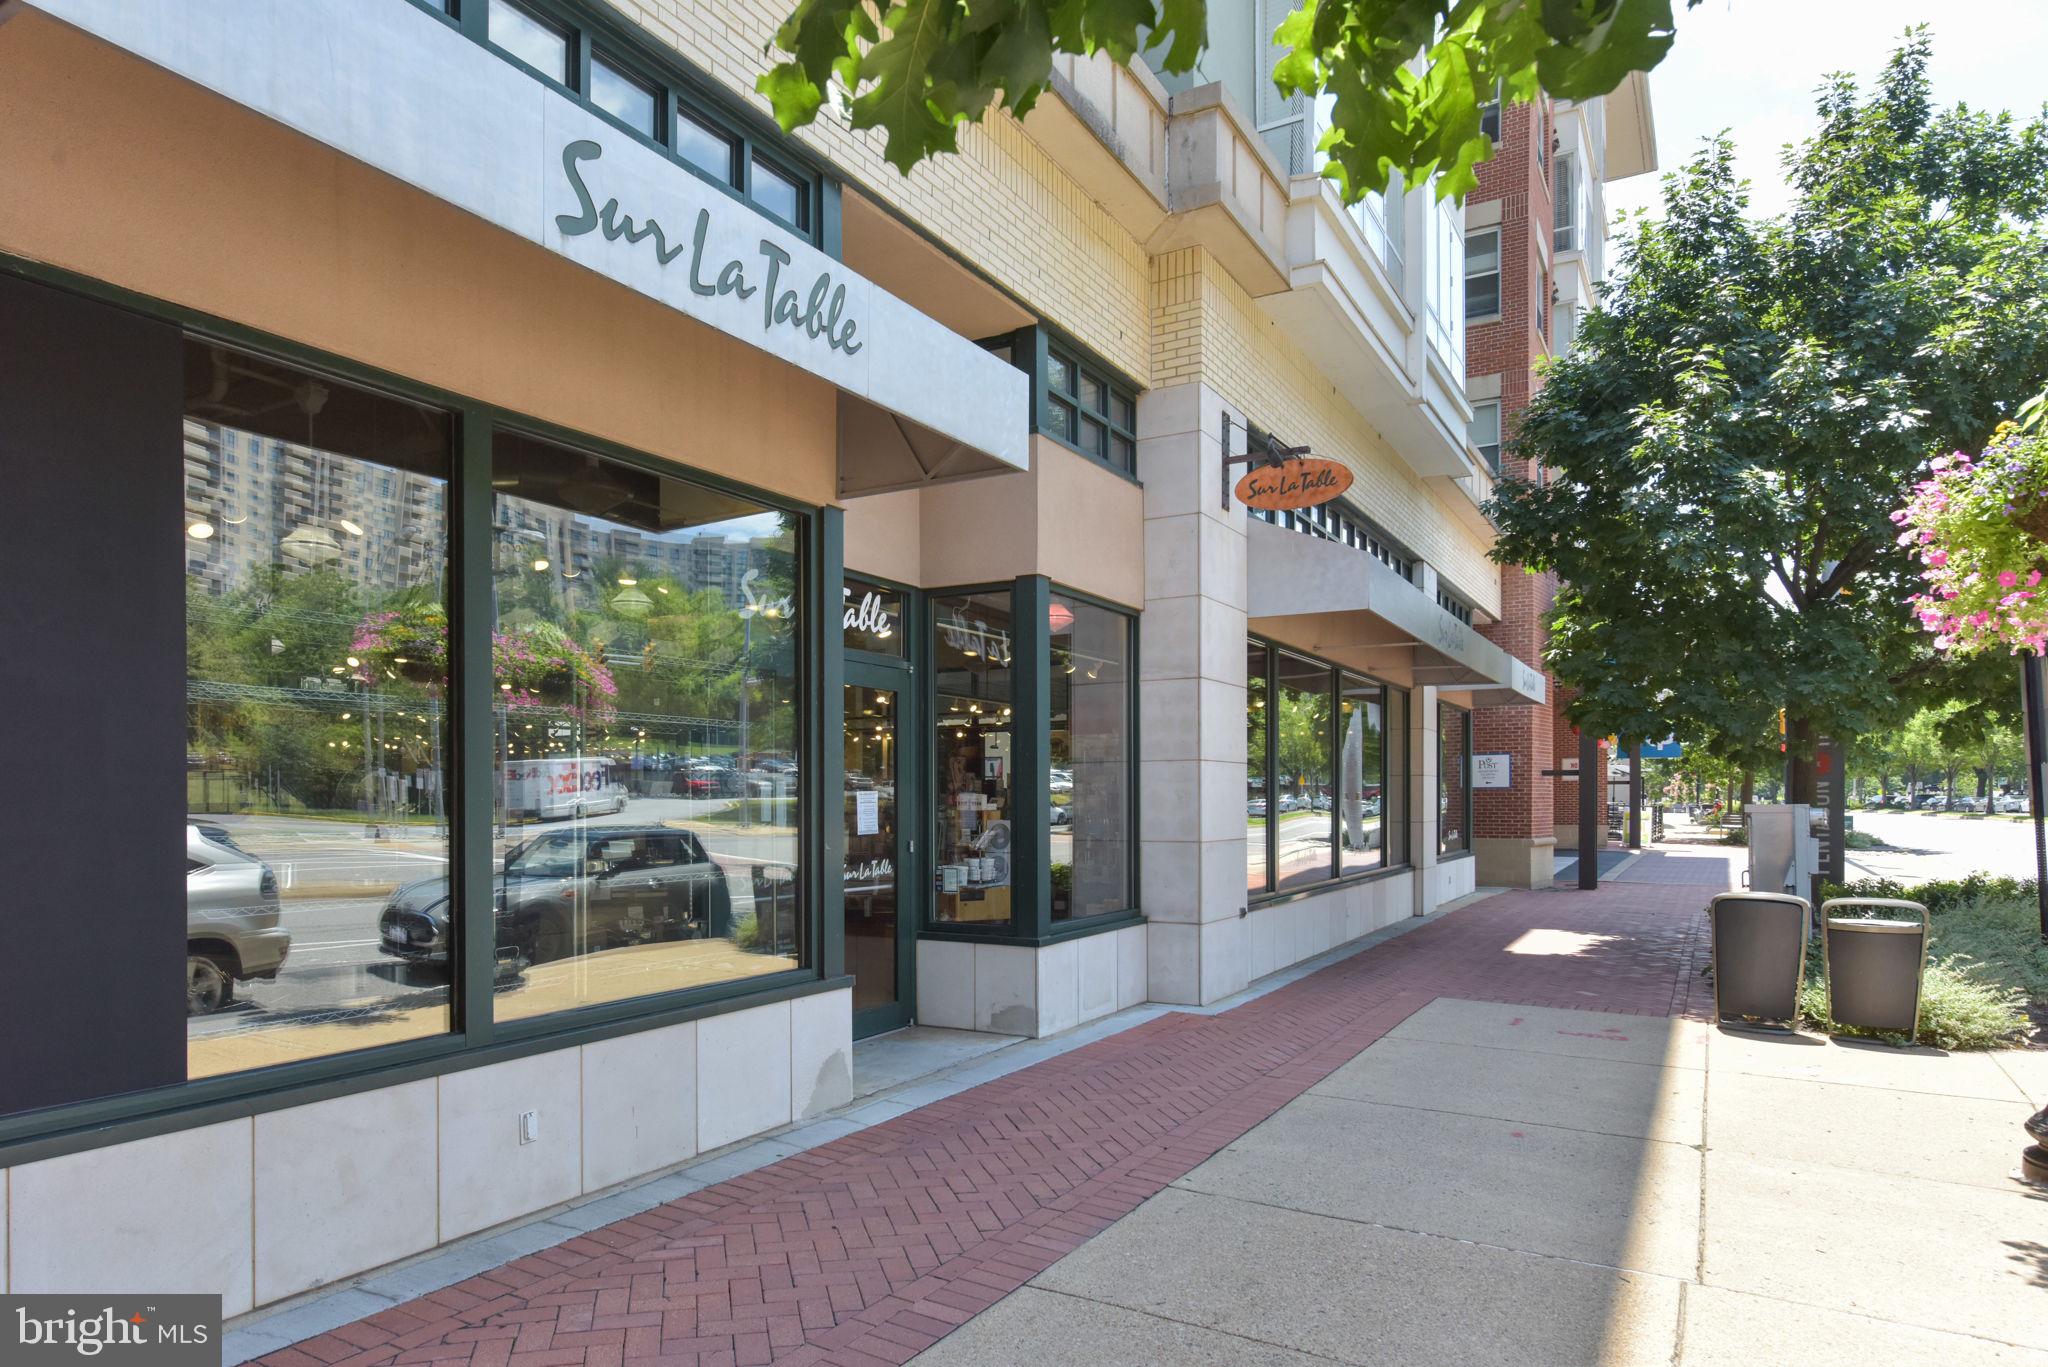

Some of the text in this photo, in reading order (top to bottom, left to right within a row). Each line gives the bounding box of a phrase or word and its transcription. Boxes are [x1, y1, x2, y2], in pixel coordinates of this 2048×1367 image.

[555, 140, 863, 356] Sur La Table
[1247, 468, 1338, 500] Sur La Table
[859, 862, 872, 880] La
[871, 858, 893, 879] Table
